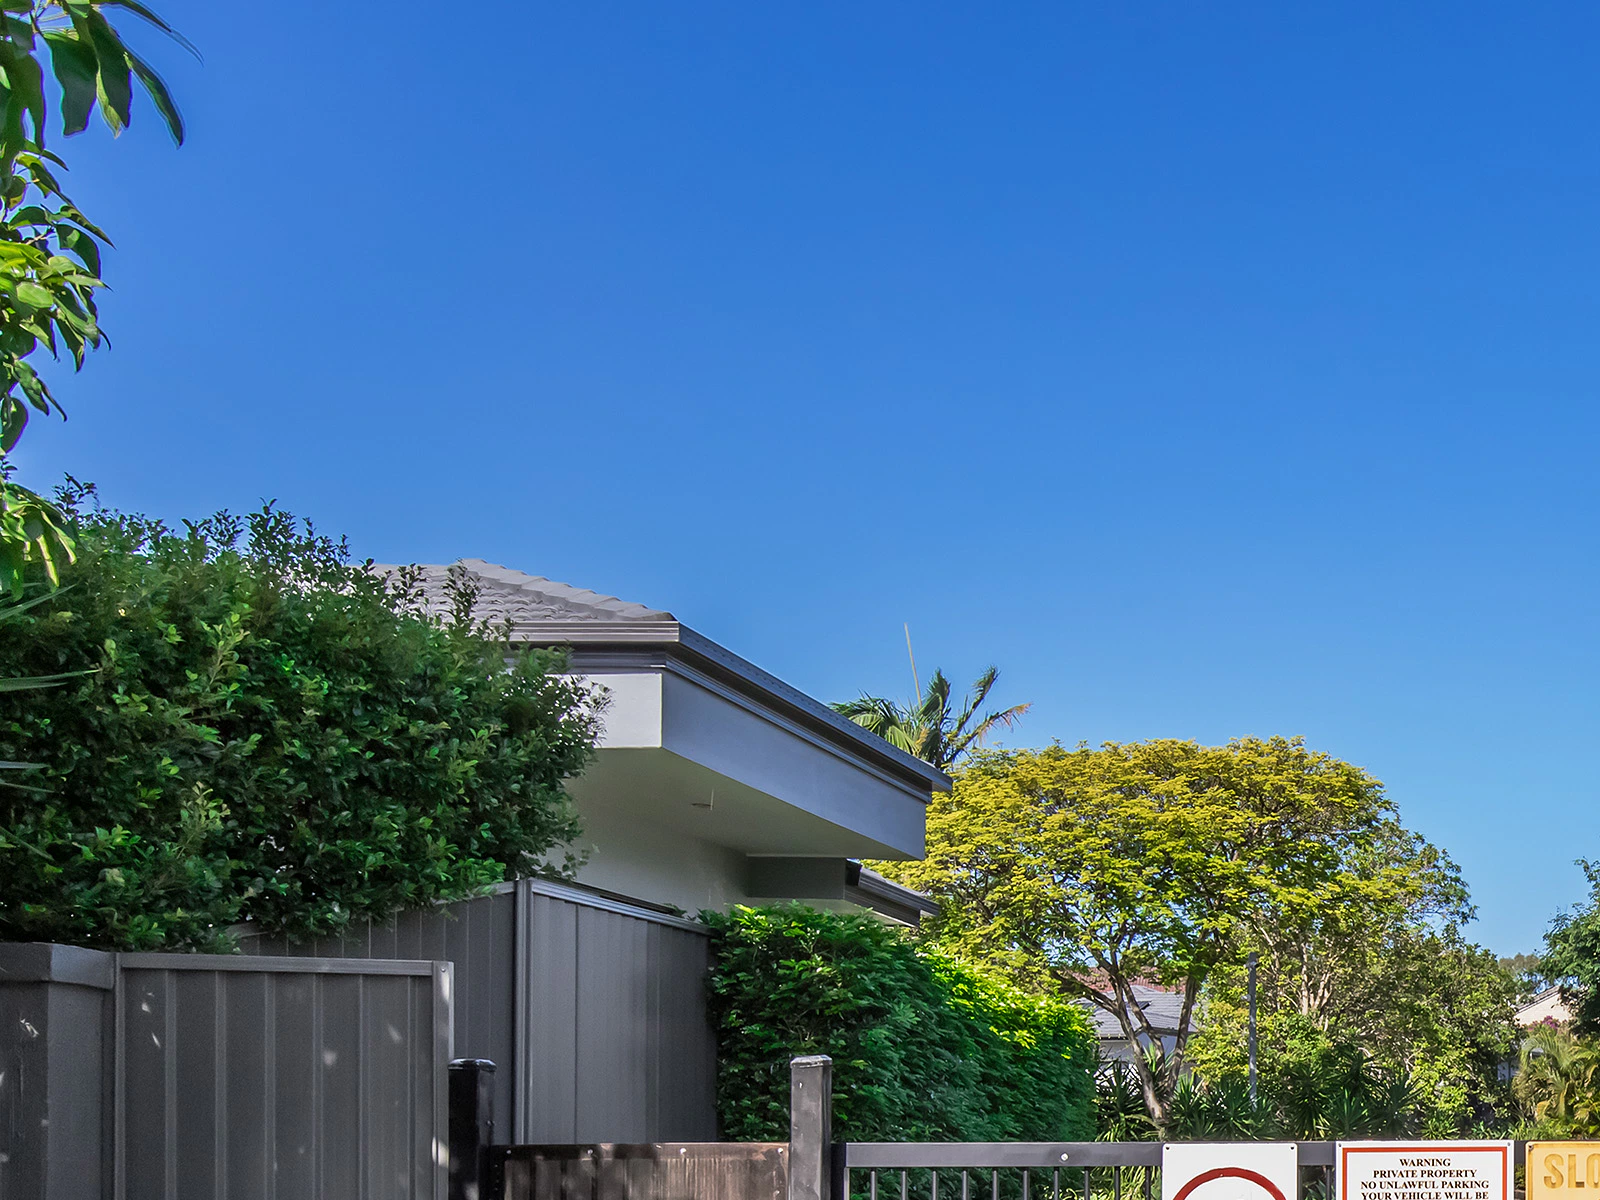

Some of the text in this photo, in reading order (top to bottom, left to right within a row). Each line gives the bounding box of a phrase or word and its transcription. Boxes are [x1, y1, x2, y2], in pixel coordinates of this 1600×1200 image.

[1399, 1158, 1451, 1167] WARNING
[1373, 1169, 1478, 1178] PRIVATE PROPERTY
[1360, 1180, 1489, 1189] NO UNLAWFUL PARKING
[1361, 1191, 1489, 1200] YOUR VEHICLE WILL BE
